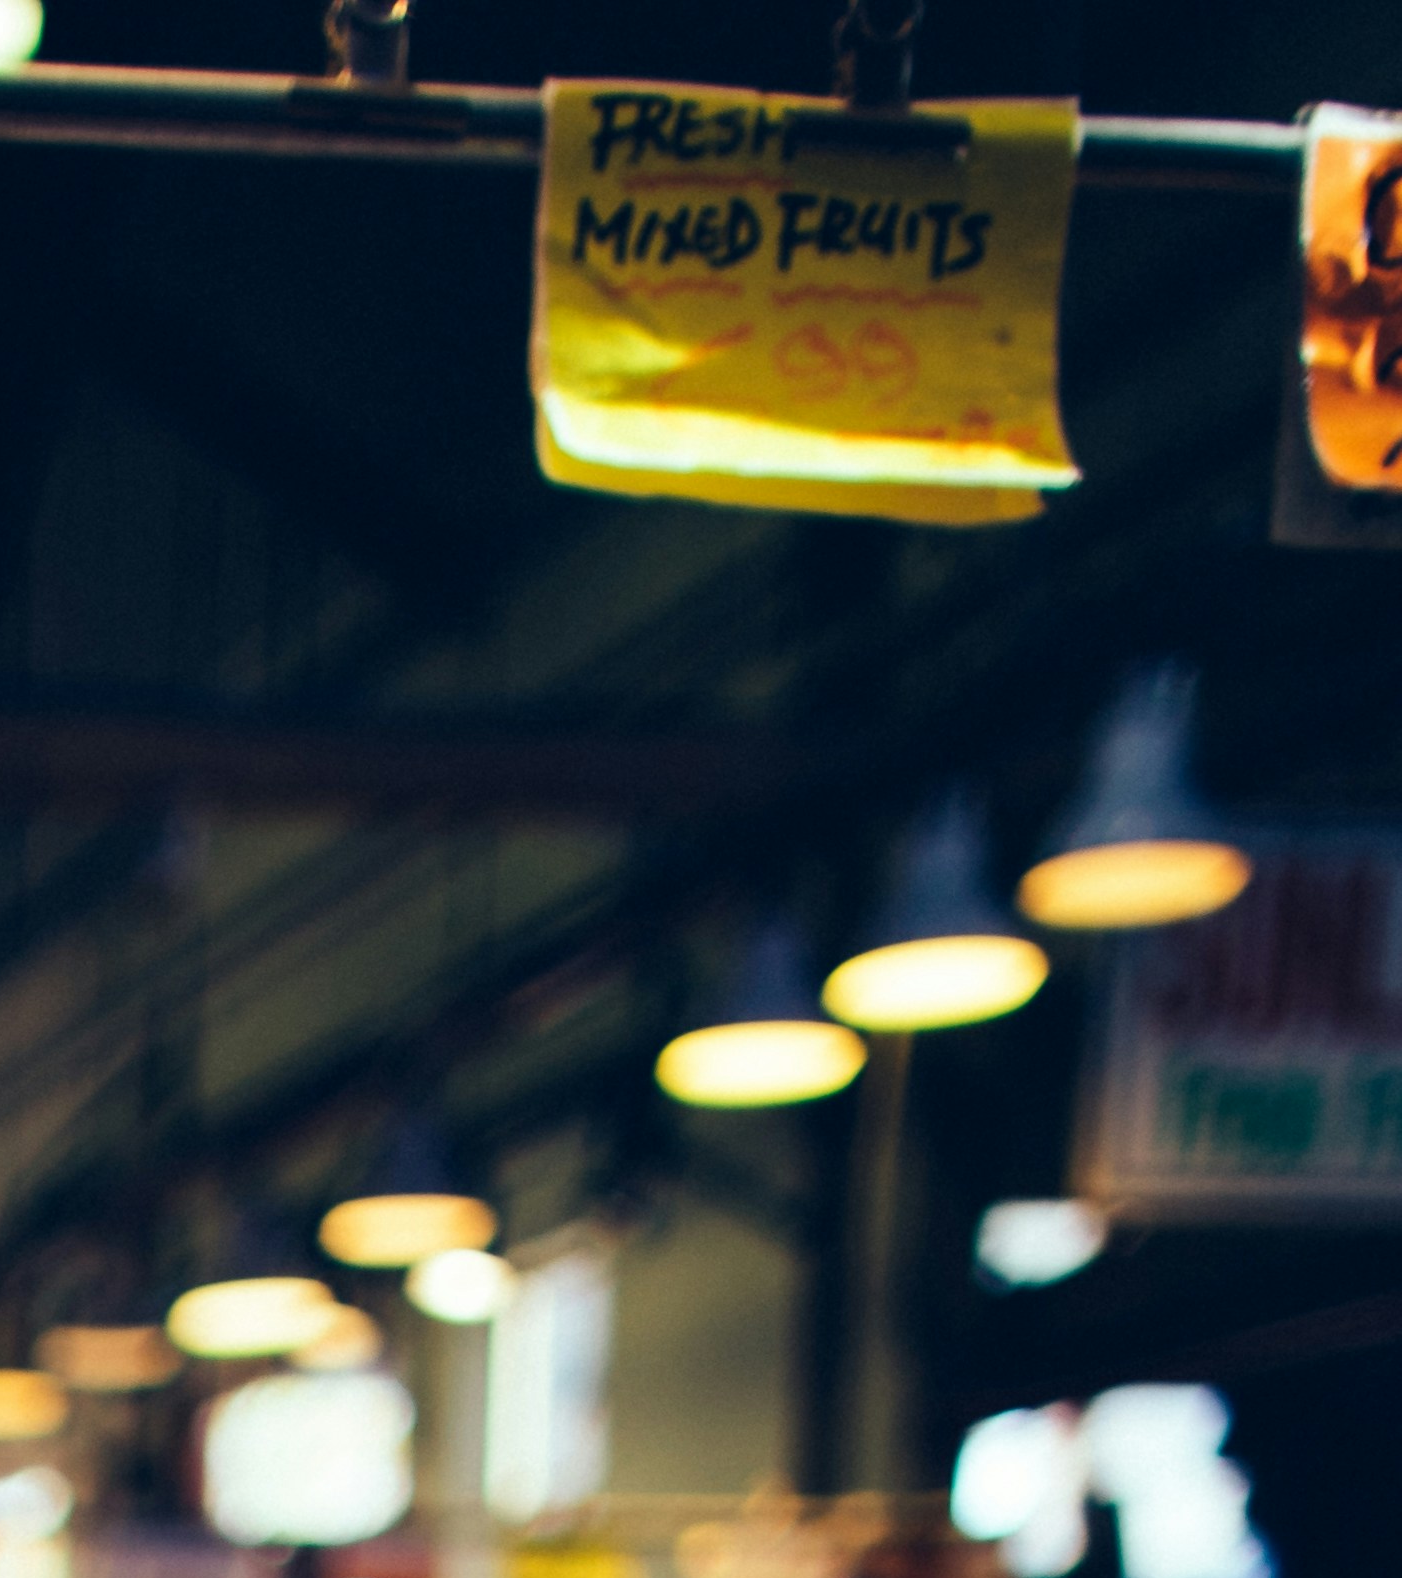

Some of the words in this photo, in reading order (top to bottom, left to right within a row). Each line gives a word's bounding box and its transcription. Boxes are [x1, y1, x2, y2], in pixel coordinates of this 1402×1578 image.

[590, 90, 795, 173] FRESH
[571, 198, 762, 269] MIXED
[776, 191, 994, 281] FRUITS
